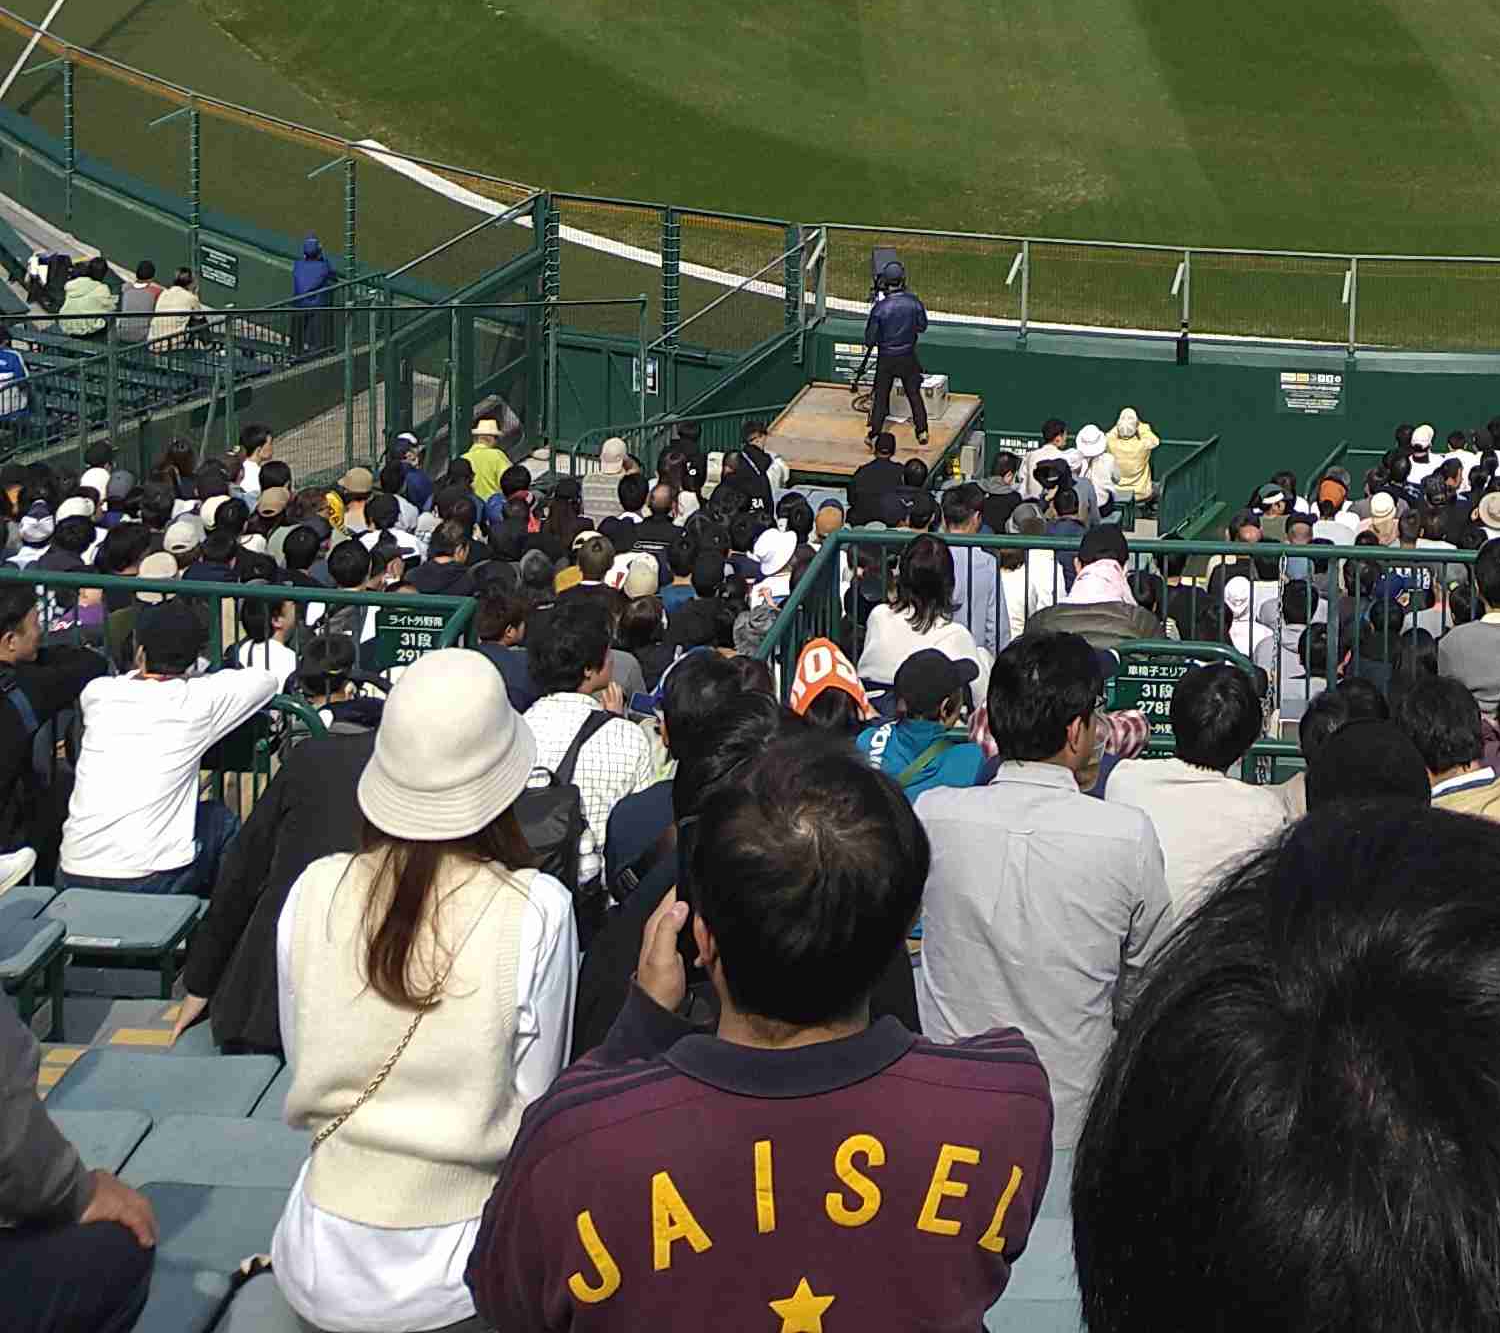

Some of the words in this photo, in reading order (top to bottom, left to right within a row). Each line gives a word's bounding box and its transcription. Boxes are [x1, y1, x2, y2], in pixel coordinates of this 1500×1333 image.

[400, 632, 433, 647] 31段
[1127, 665, 1187, 677] 車椅子エリア
[1142, 683, 1175, 699] 31段
[567, 1133, 1024, 1304] JAISEL
